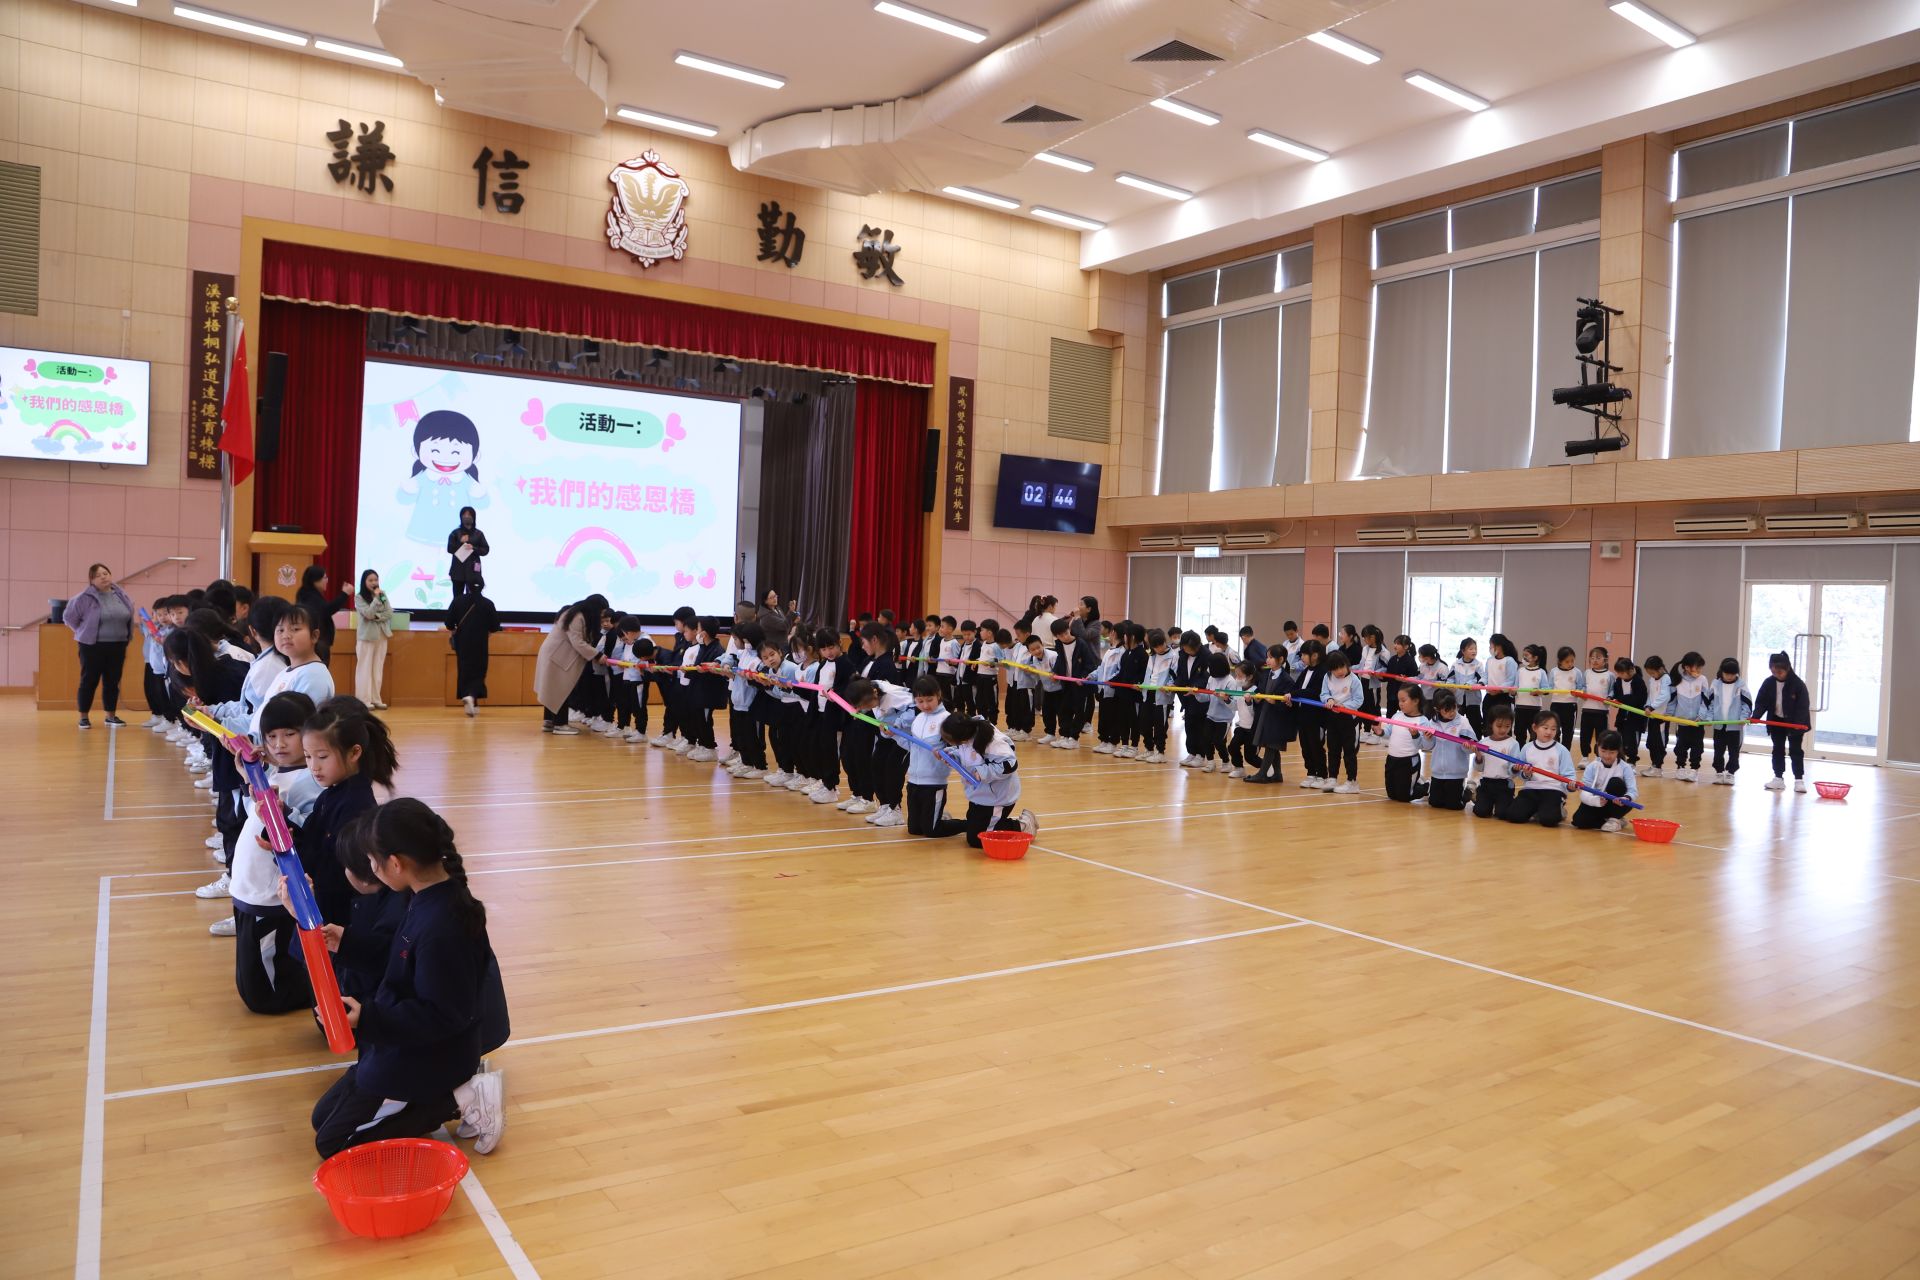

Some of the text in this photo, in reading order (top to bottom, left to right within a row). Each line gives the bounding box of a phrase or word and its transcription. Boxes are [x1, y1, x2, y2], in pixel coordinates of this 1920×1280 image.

[29, 395, 124, 416] 我們的感恩橋
[529, 477, 696, 516] 我們的感恩橋
[1024, 485, 1073, 506] 02 44
